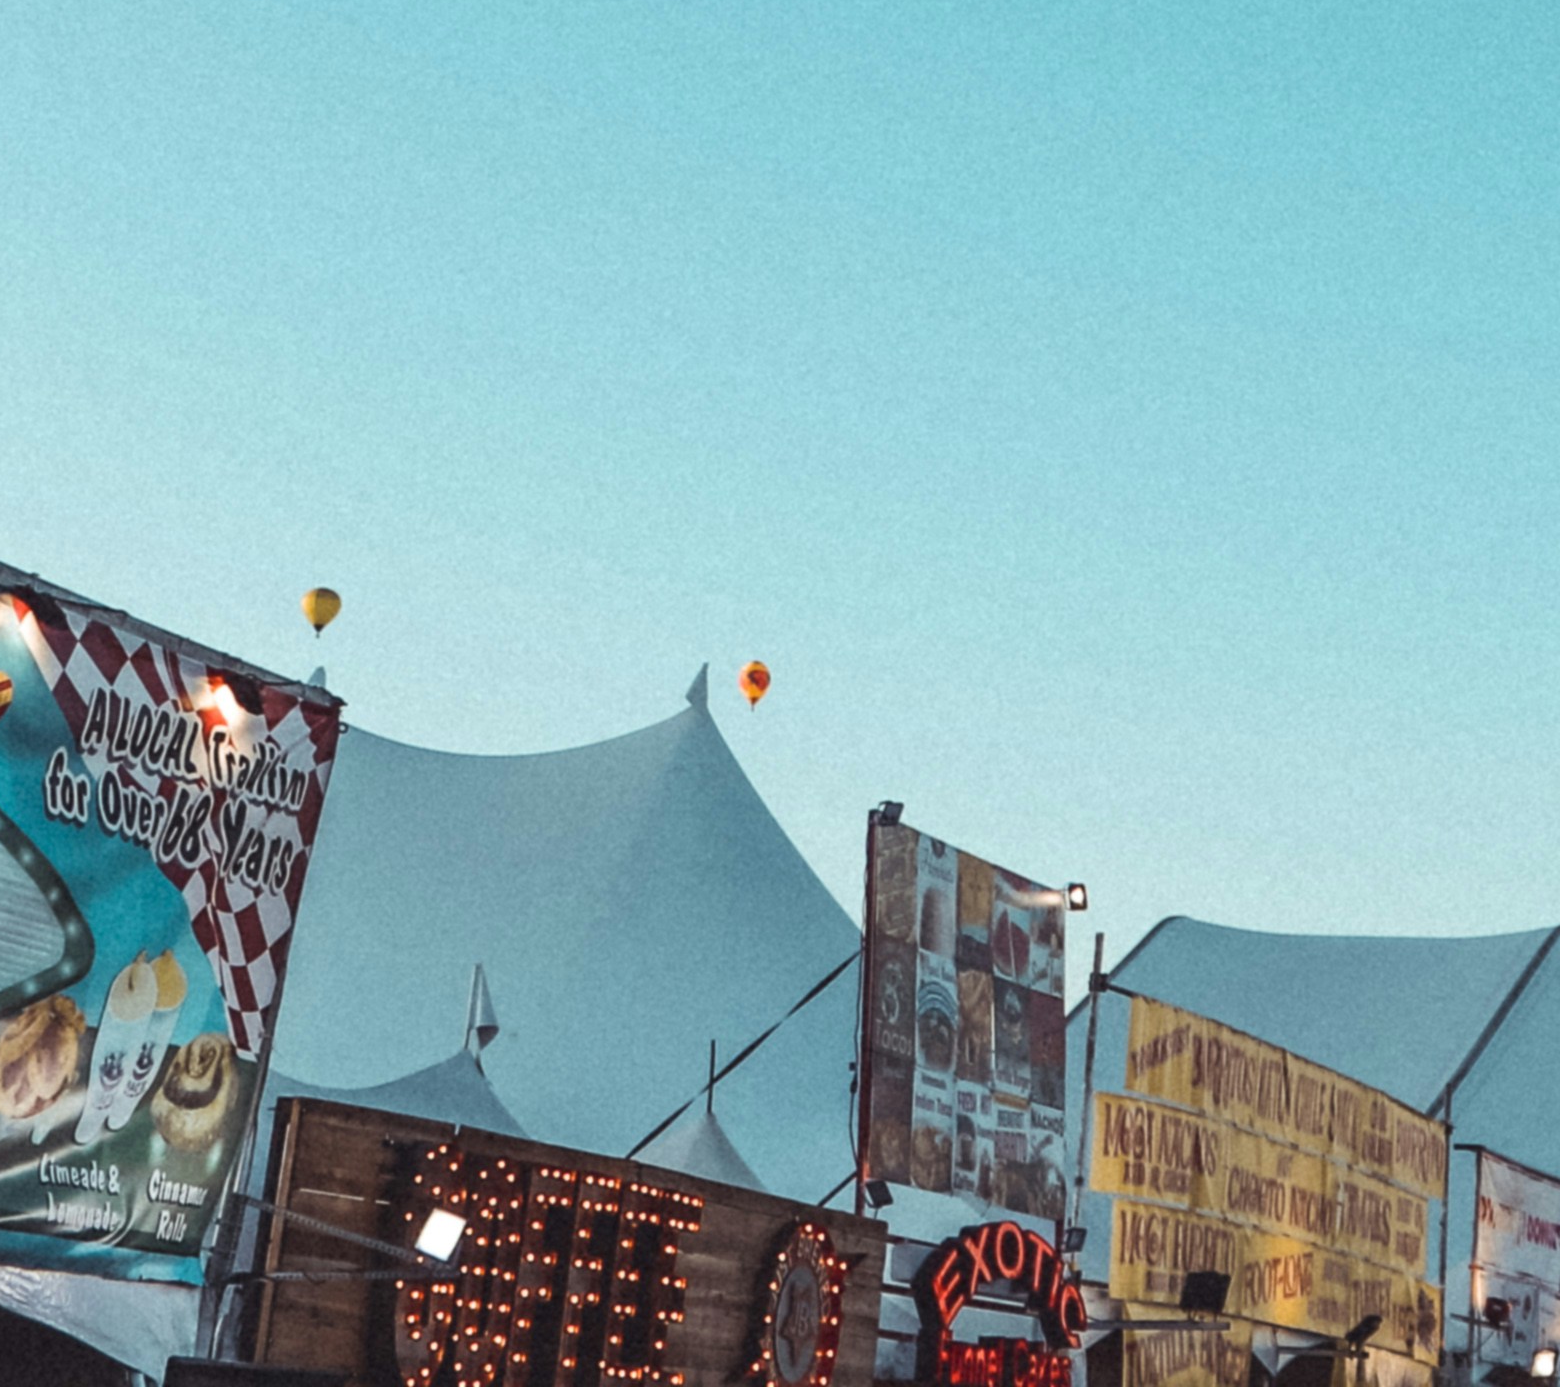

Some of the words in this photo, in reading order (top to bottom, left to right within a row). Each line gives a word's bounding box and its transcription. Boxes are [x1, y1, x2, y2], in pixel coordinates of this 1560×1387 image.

[83, 687, 108, 747] A
[112, 695, 200, 774] LOCAL
[47, 751, 89, 819] for
[100, 770, 168, 840] Over
[40, 1153, 106, 1191] Limeade
[156, 1210, 188, 1244] Rolls
[932, 1220, 1087, 1349] EXOTIC
